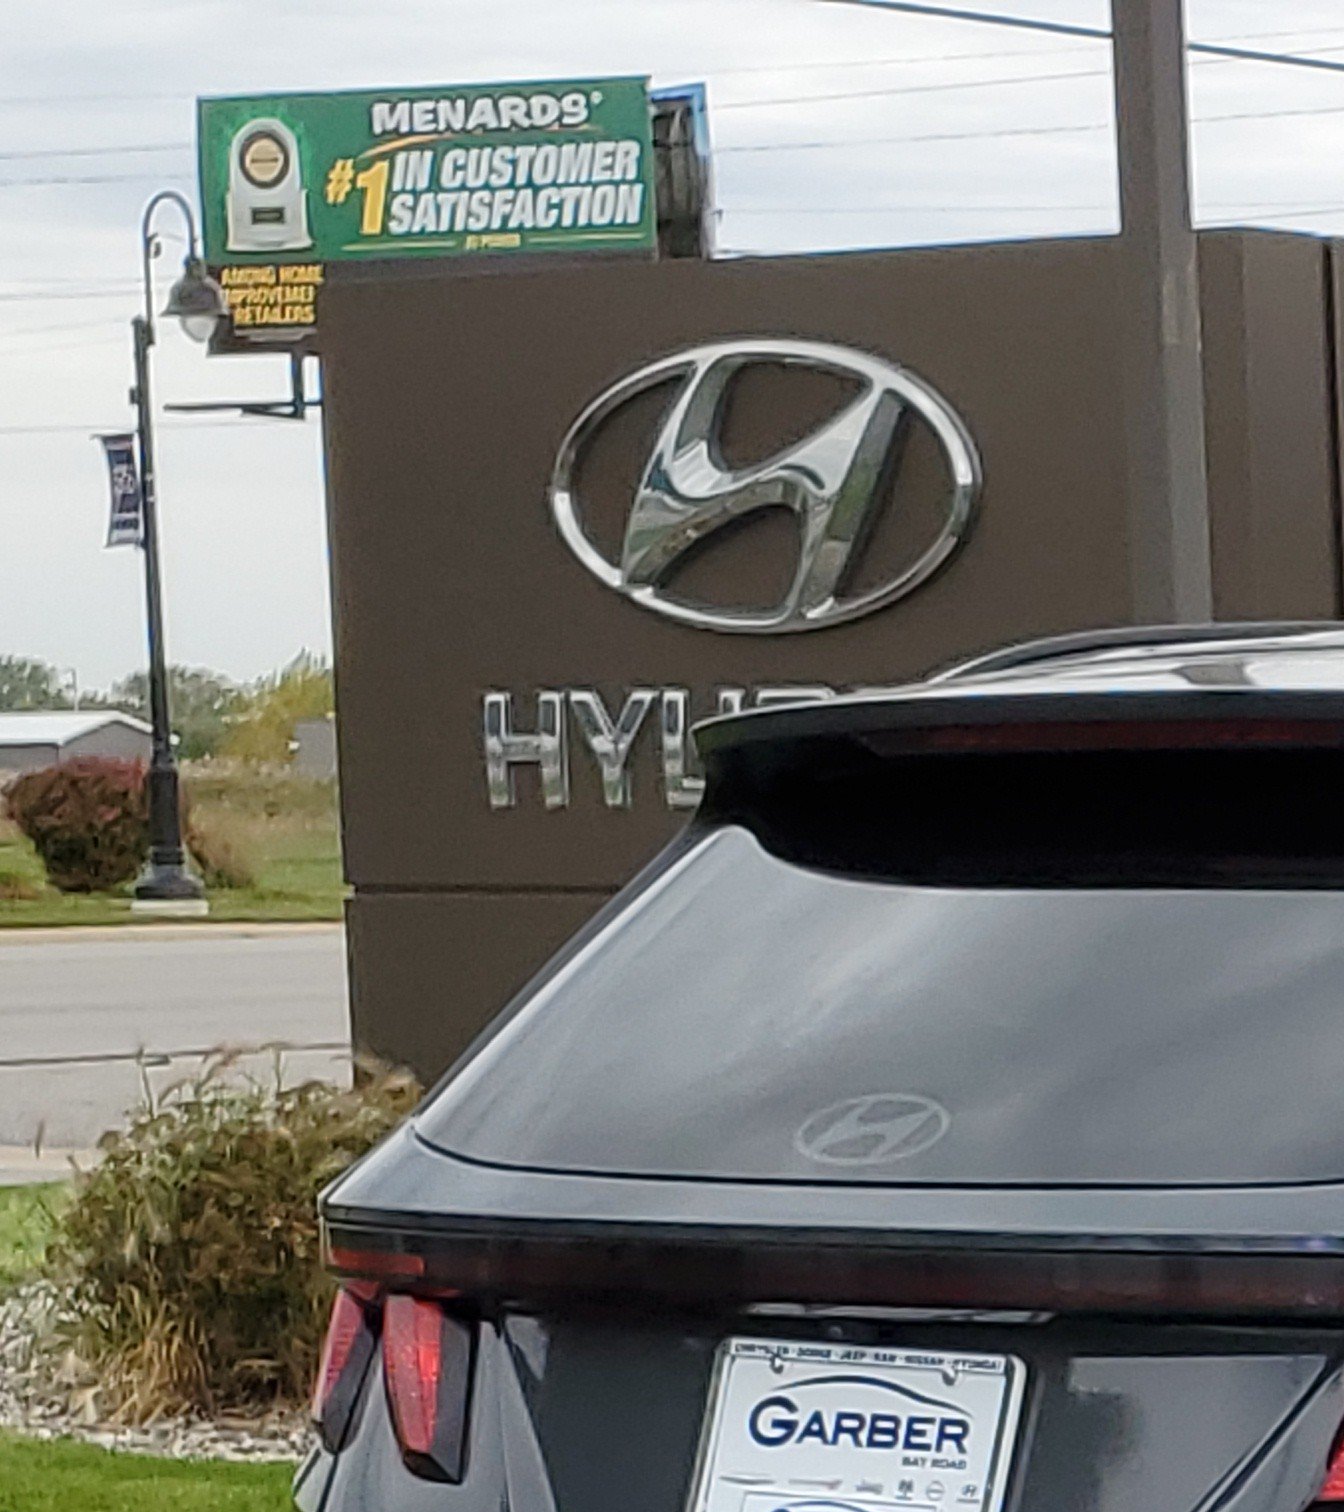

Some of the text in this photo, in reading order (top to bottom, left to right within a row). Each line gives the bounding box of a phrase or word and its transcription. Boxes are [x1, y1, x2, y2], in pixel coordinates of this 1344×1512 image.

[371, 92, 588, 135] MENARDS
[325, 140, 641, 235] #1 IN CUSTOMER
[387, 183, 644, 235] SATISFACTION
[483, 685, 838, 810] HYU
[749, 1395, 970, 1454] GARBER
